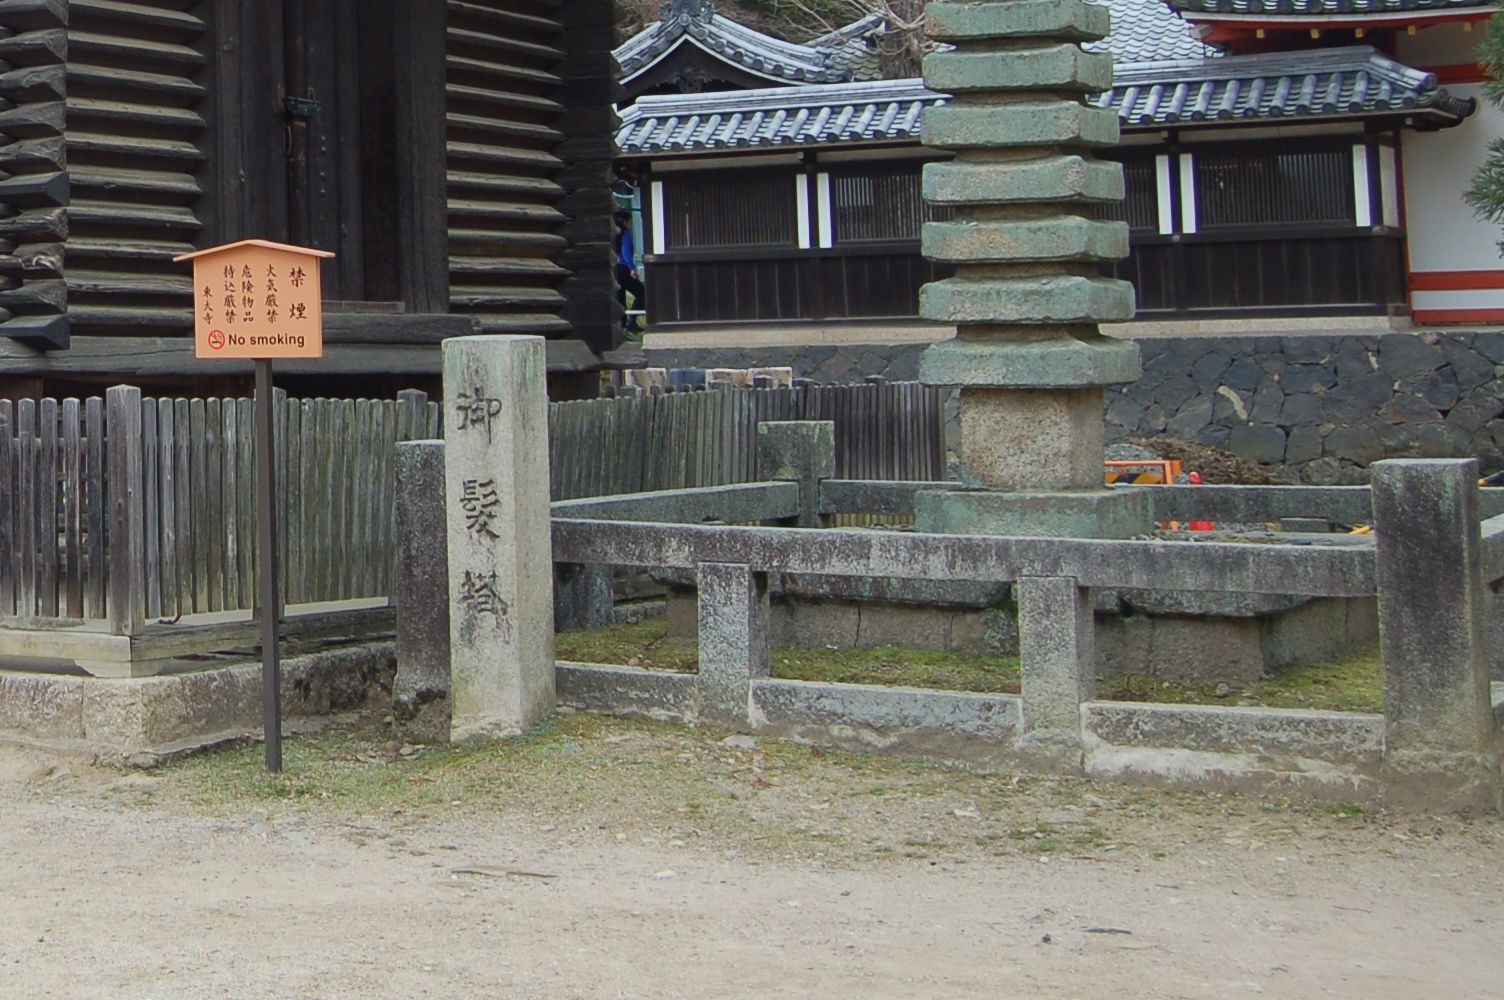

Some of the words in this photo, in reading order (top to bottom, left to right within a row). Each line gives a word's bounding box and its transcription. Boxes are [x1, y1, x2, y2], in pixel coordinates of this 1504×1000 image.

[203, 286, 213, 325] 東大寺
[224, 264, 237, 324] 持込厳禁
[242, 264, 254, 322] 危険物品
[265, 264, 278, 324] 火気厳禁
[289, 267, 307, 320] 禁煙
[229, 334, 245, 345] No
[250, 333, 304, 347] smoking
